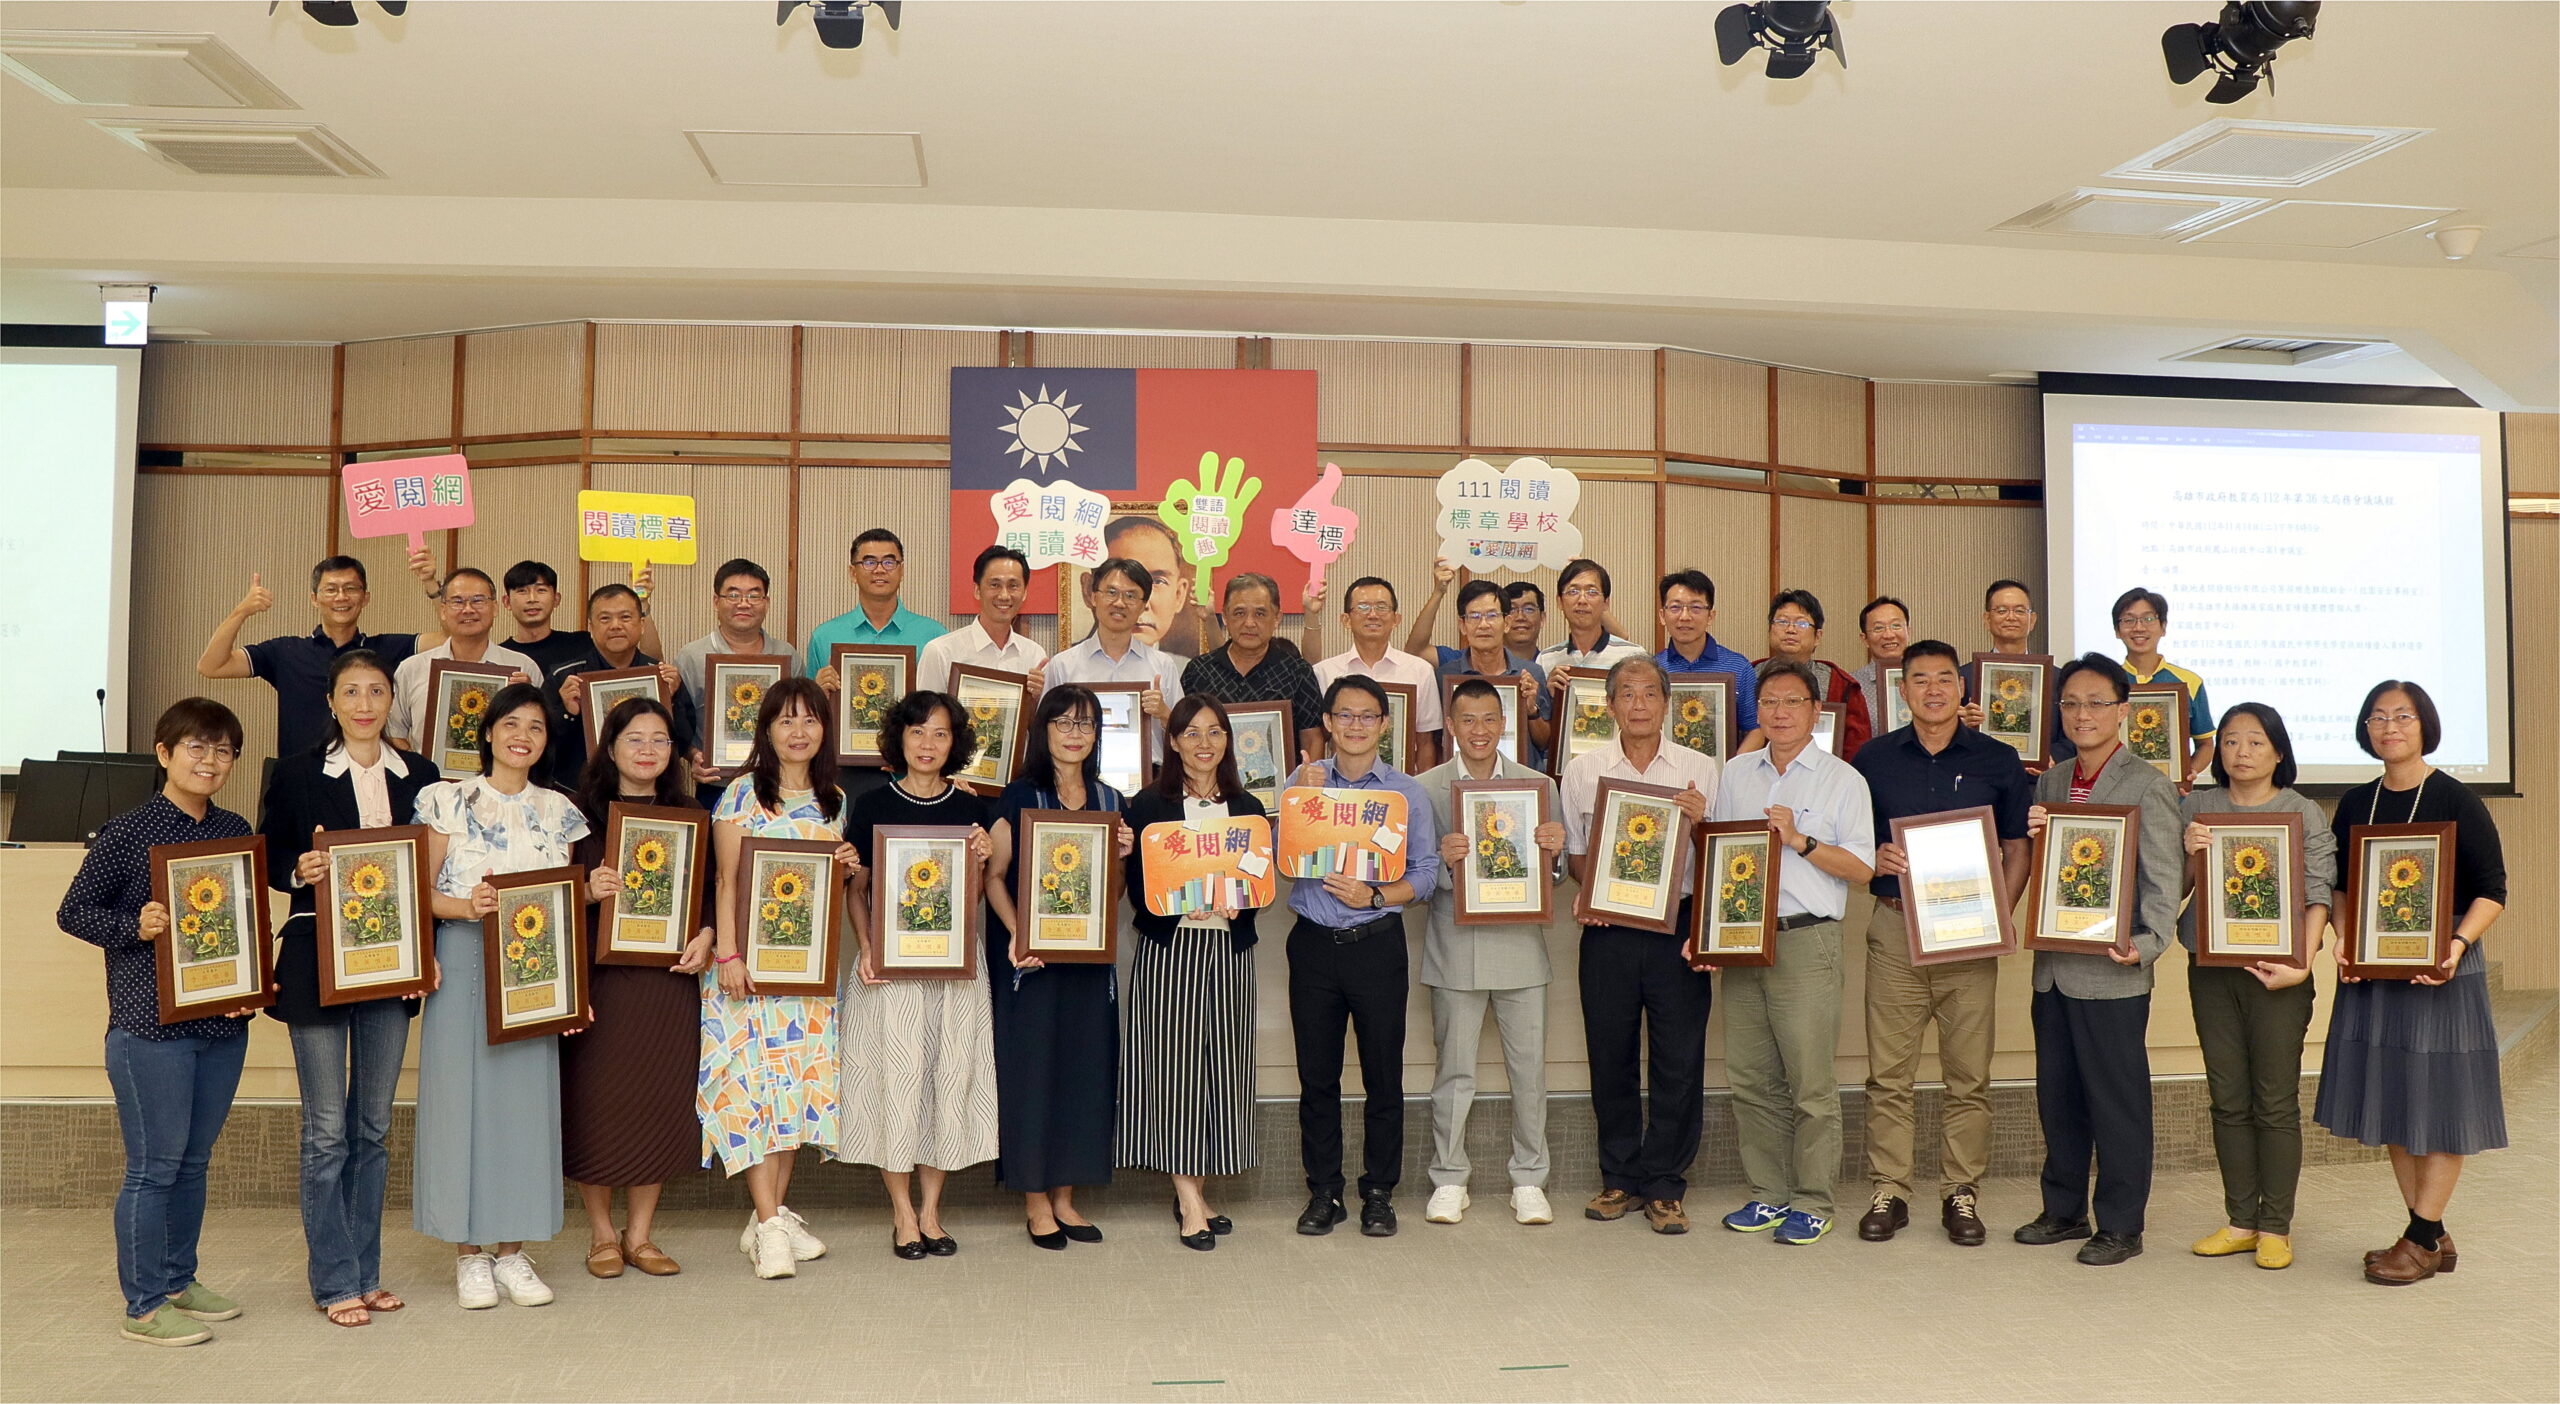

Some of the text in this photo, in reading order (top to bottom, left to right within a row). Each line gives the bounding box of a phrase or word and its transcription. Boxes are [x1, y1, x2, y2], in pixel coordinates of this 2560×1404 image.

[353, 474, 464, 516] 愛閱網
[1003, 492, 1104, 528] 愛閱網
[1195, 497, 1224, 513] 雙語
[583, 510, 693, 542] 閱讀標章
[1191, 515, 1230, 536] 閱讀
[1291, 509, 1344, 552] 達標
[1449, 508, 1559, 533] 標章學校
[1006, 530, 1100, 562] 閱讀樂
[1197, 538, 1217, 556] 趣
[1484, 541, 1535, 559] 愛閱網
[1300, 796, 1390, 827] 愛閱網
[1163, 826, 1252, 863] 愛閱網
